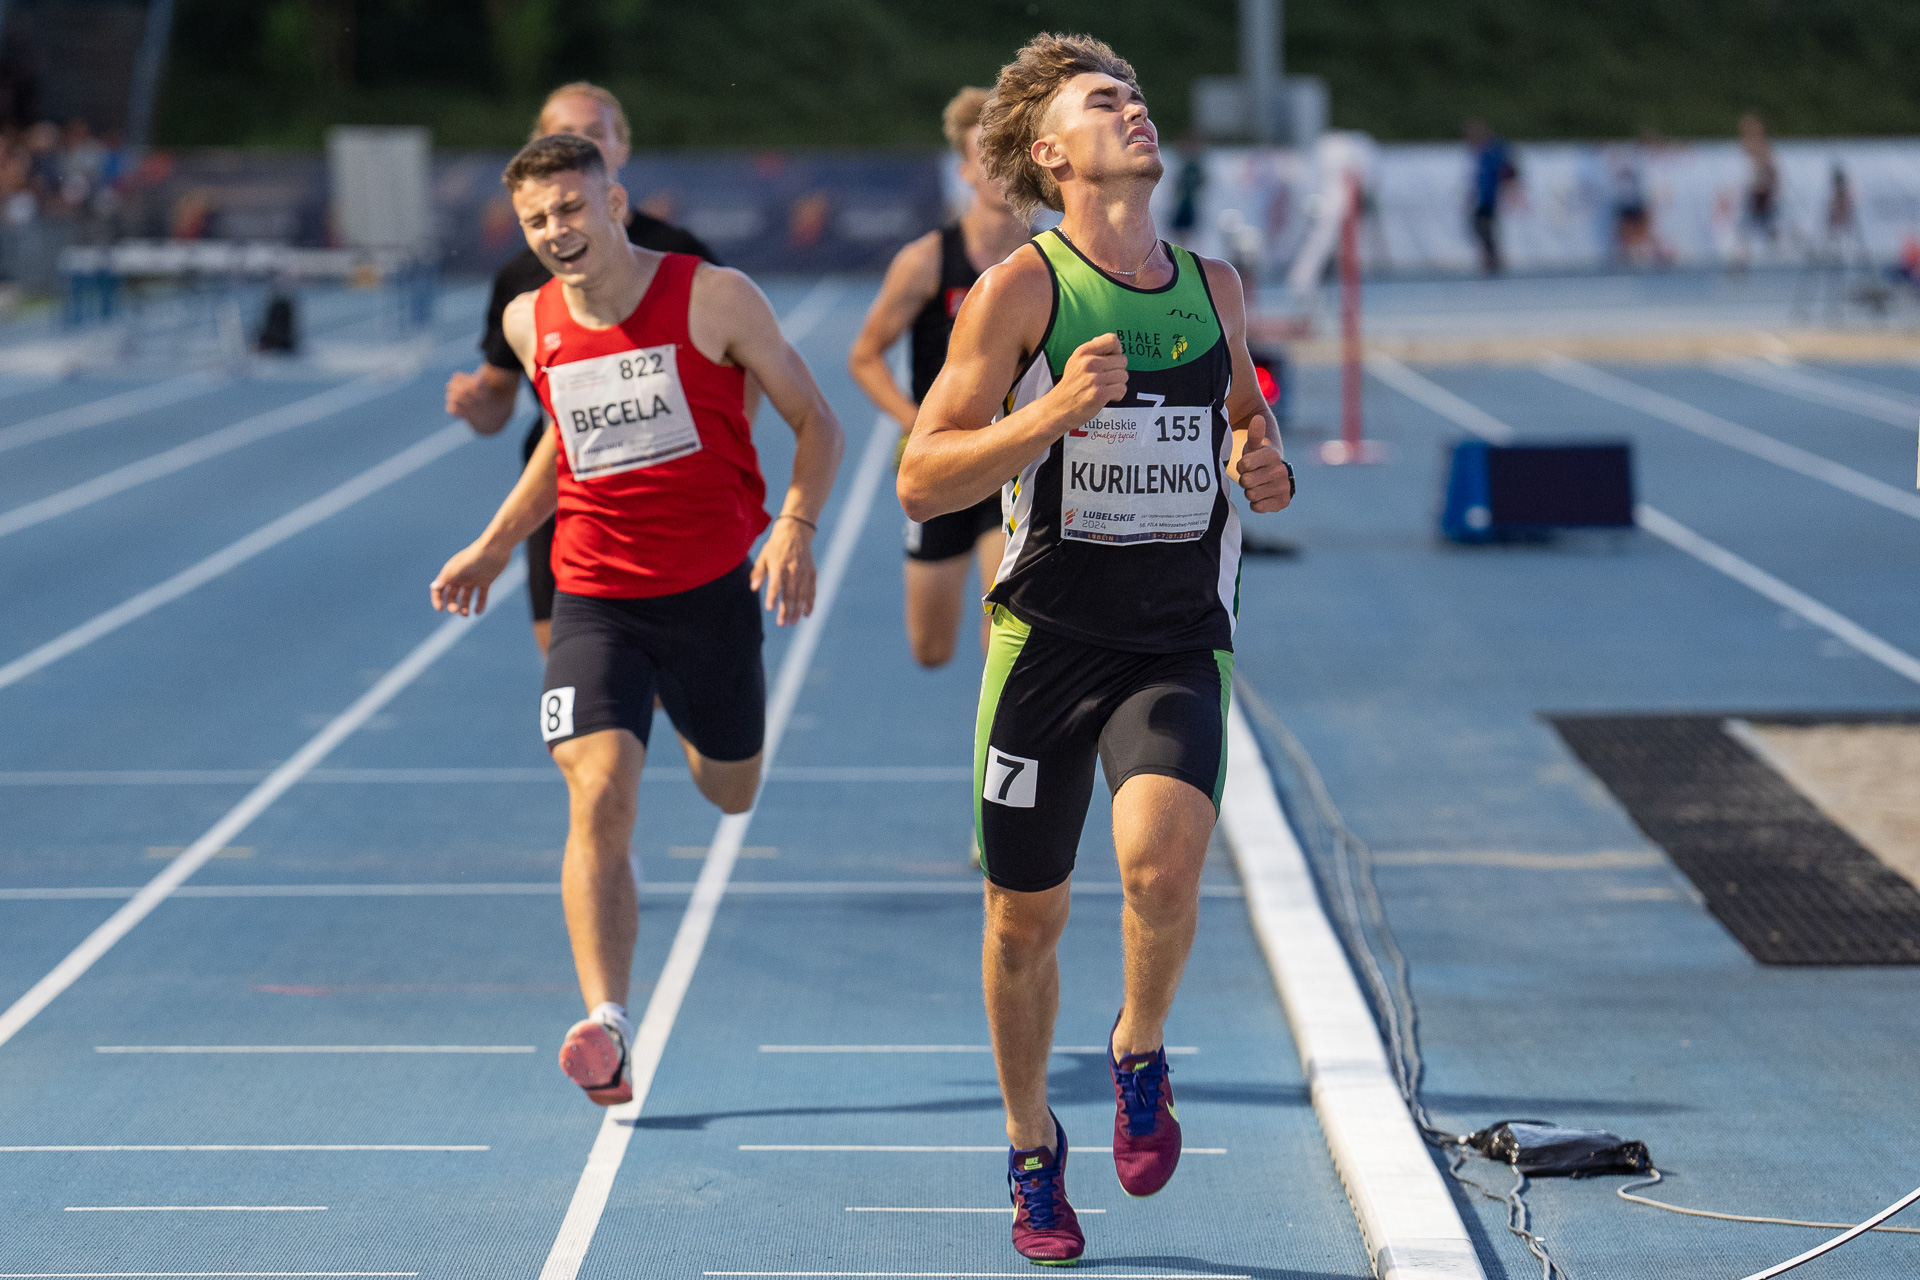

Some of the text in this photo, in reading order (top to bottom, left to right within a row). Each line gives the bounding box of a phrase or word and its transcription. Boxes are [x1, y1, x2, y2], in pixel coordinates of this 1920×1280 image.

[619, 353, 665, 379] 822
[571, 394, 672, 433] BECELA
[1154, 416, 1201, 442] 155
[1070, 461, 1211, 494] KURILENKO
[1082, 520, 1106, 529] 2024
[547, 695, 561, 732] 8
[996, 754, 1025, 801] 7
